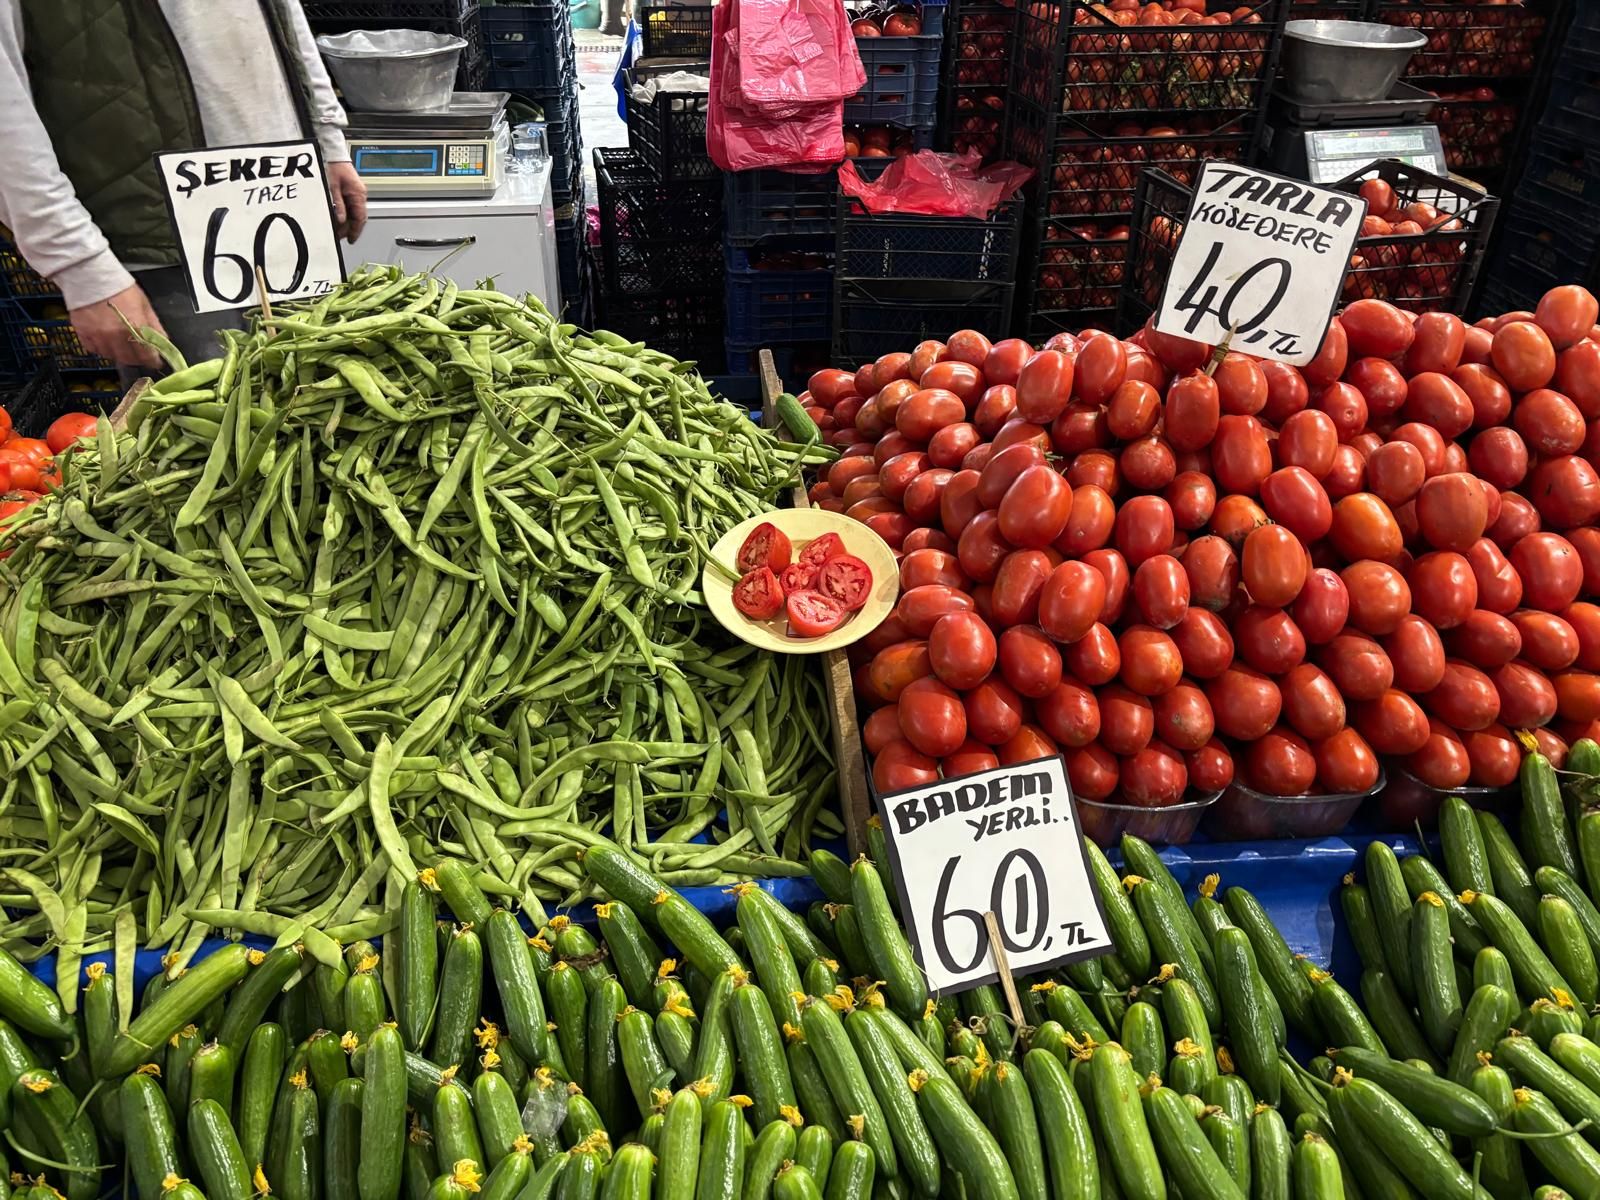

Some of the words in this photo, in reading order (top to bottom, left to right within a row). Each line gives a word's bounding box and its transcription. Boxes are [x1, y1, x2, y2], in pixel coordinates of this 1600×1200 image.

[175, 152, 315, 199] ŞEKER
[243, 183, 298, 206] TAZE
[1206, 168, 1353, 228] TARLA
[892, 771, 1053, 835] BADEM
[1060, 921, 1099, 946] TL
